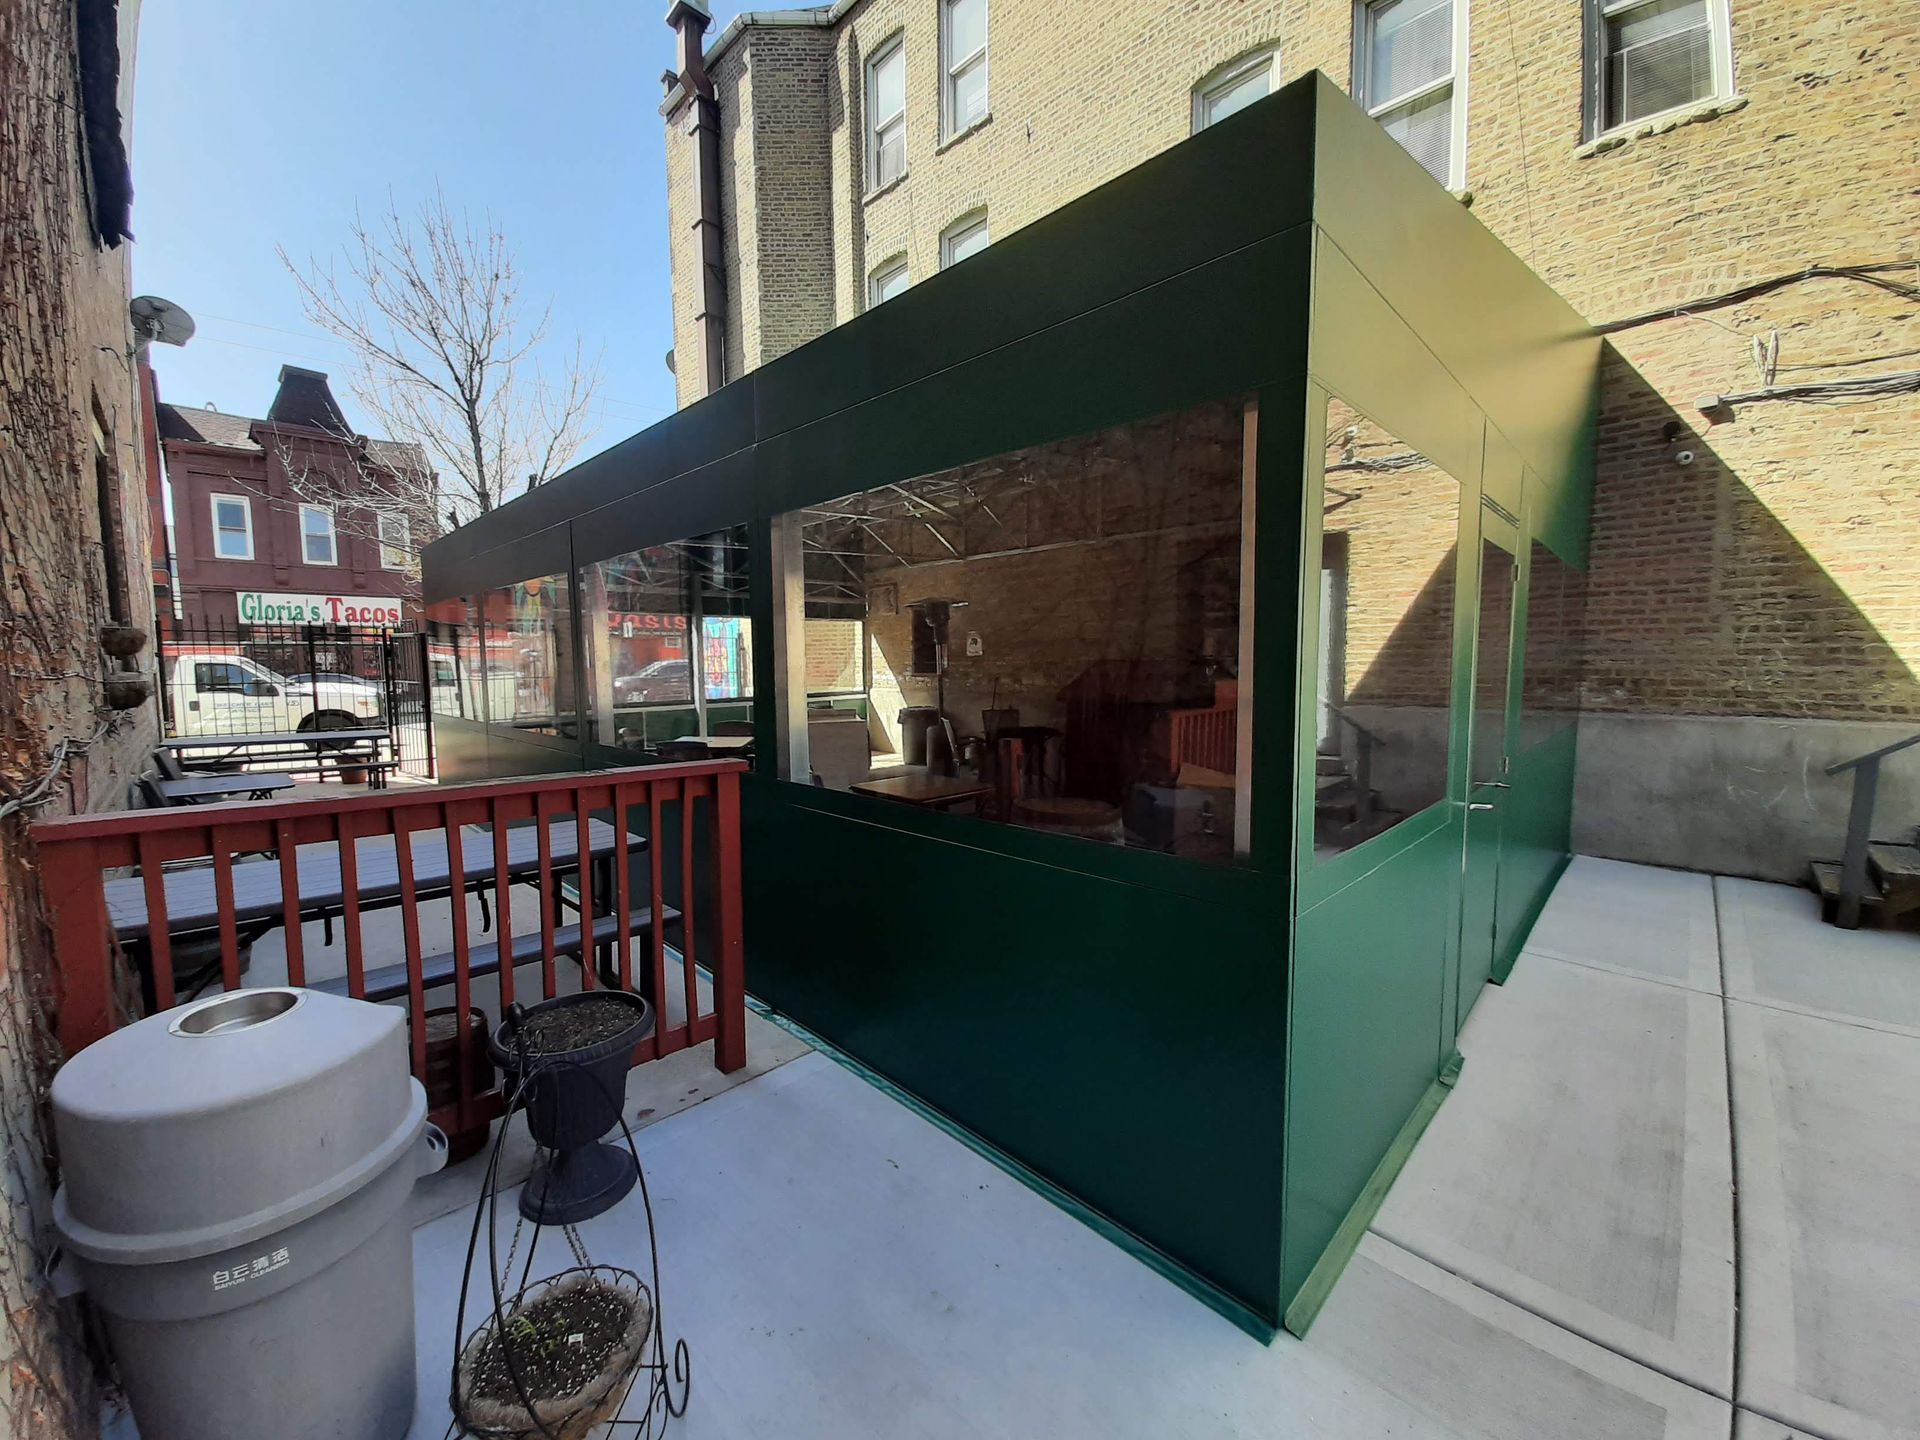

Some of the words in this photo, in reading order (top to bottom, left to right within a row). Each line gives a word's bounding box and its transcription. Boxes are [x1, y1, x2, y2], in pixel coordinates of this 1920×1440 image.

[241, 593, 321, 622] Gloria's
[325, 597, 400, 623] Tacos
[214, 1277, 246, 1291] BAIYUN
